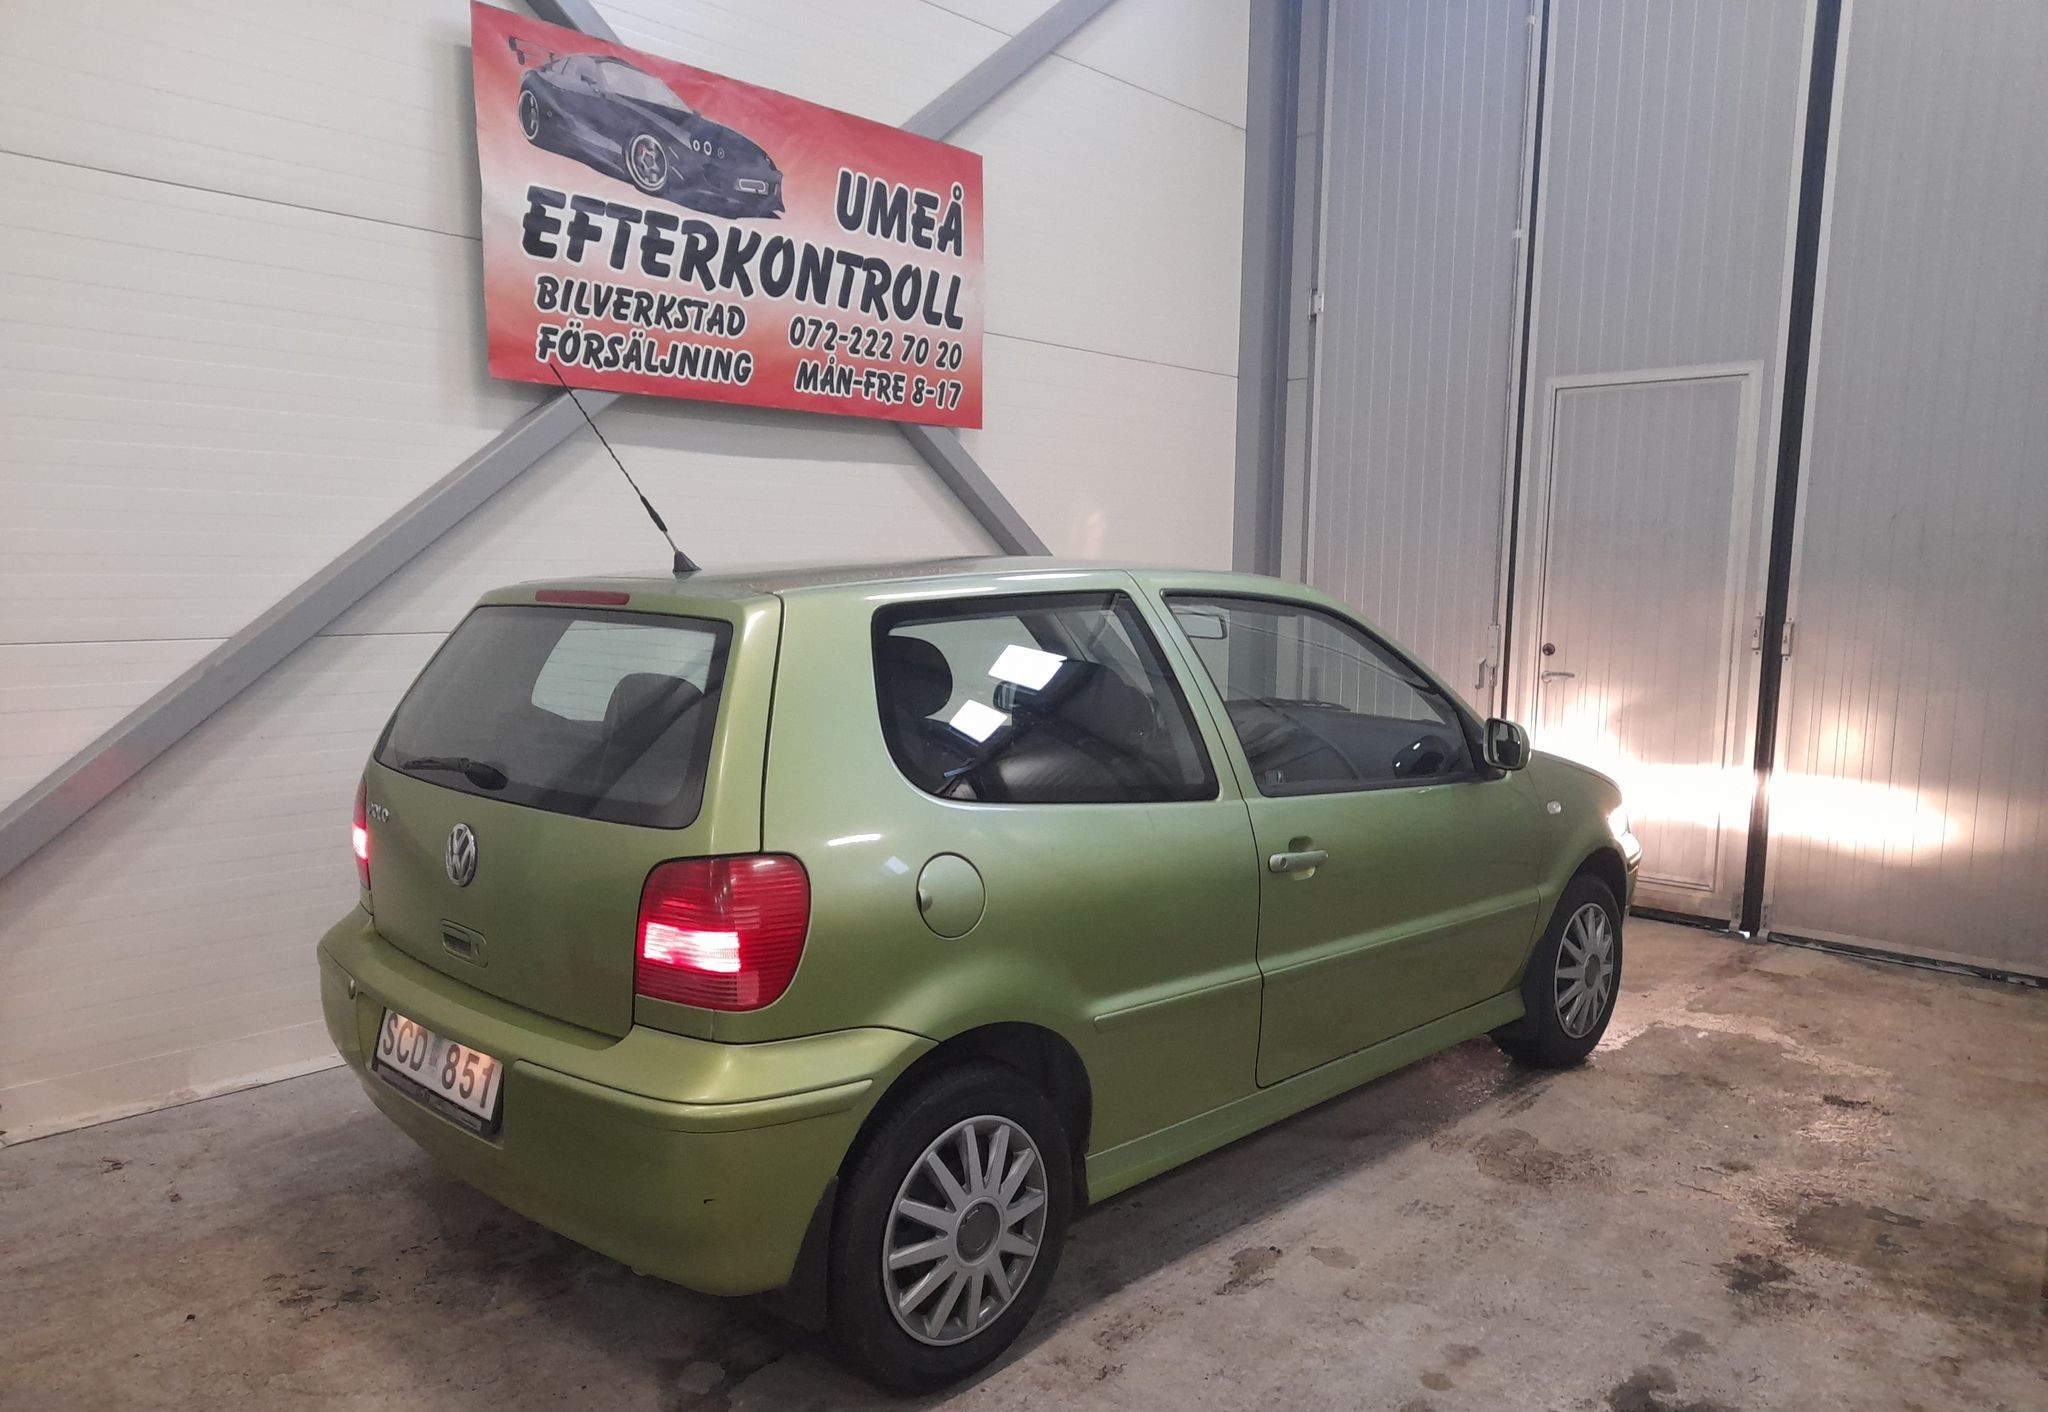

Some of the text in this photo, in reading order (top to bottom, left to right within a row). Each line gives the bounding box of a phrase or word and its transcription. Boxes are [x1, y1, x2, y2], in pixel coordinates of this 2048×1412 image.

[837, 170, 963, 257] UMEÅ
[522, 186, 964, 330] EFTERKONTROLL
[537, 275, 746, 337] BILVERKSTAD
[538, 320, 752, 383] FÖRSÄLJNING
[789, 316, 963, 370] 072-222 70 20
[795, 356, 963, 409] MÅN-FRE 8-17
[382, 1012, 495, 1109] SCD 851
